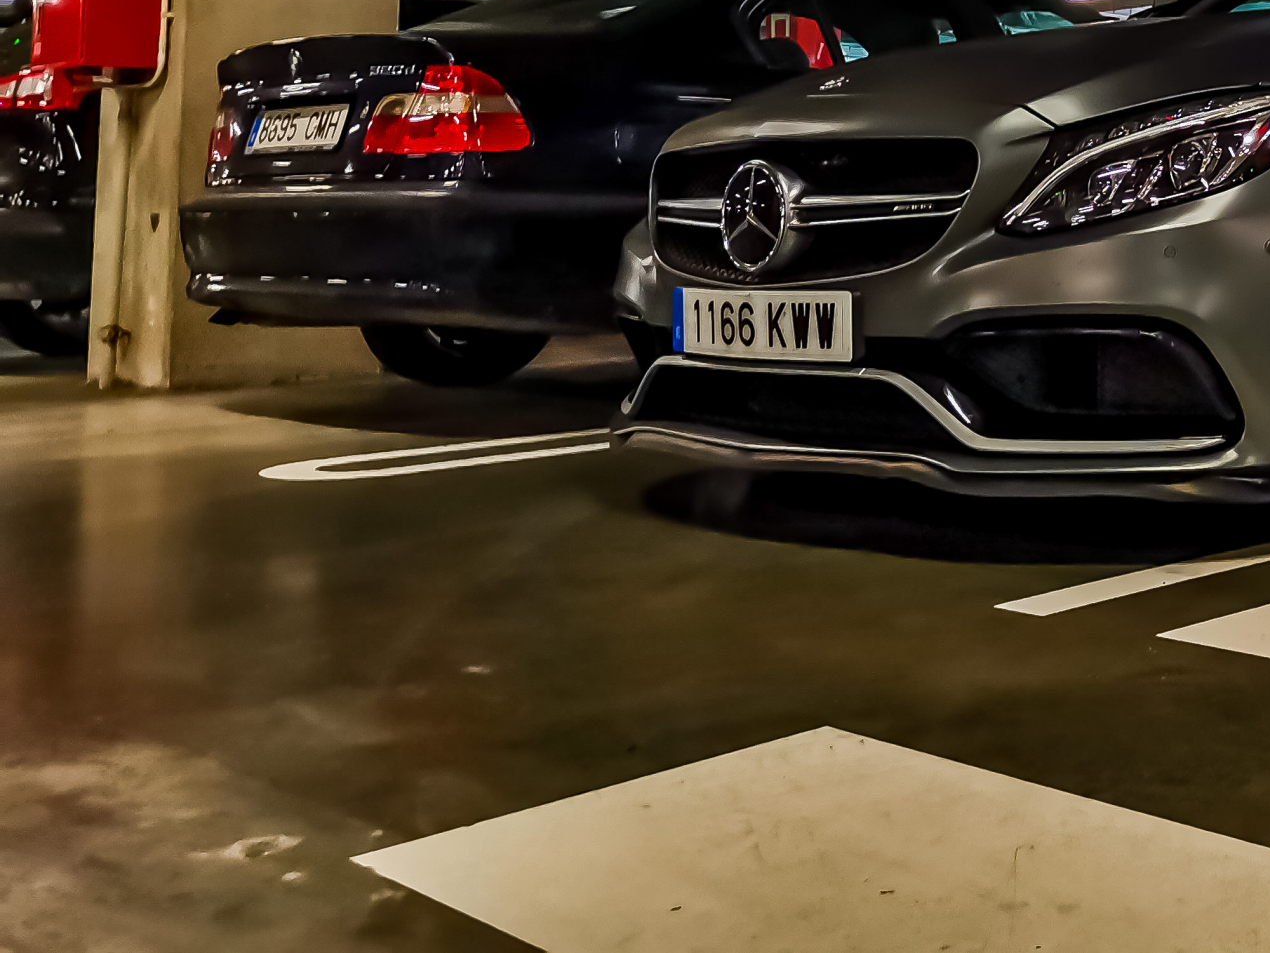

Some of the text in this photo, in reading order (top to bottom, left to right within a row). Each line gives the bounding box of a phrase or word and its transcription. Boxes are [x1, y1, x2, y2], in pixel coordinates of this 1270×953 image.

[259, 109, 342, 145] 8695 CMH
[693, 299, 836, 350] 1166 KWW
